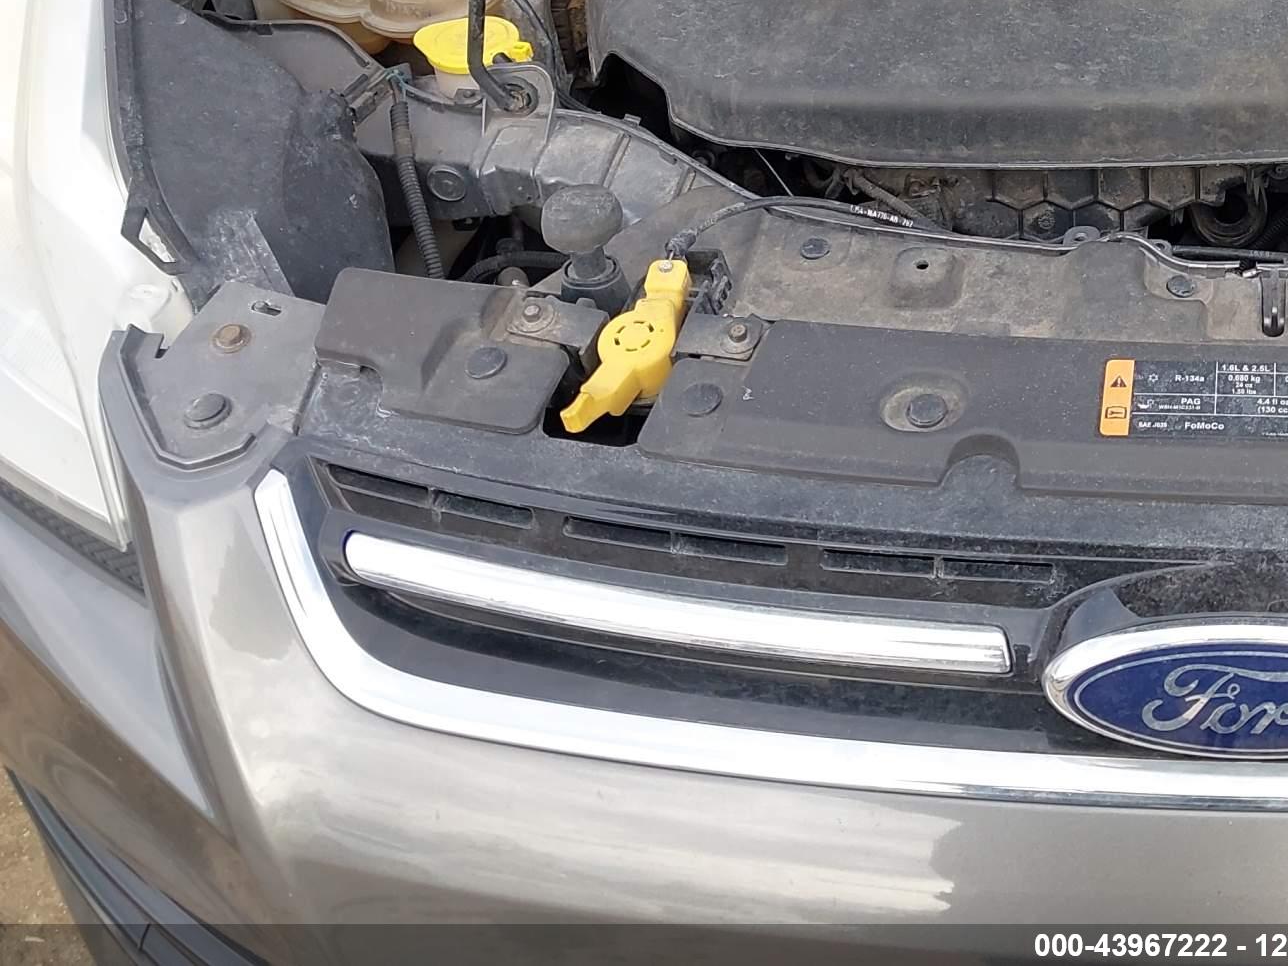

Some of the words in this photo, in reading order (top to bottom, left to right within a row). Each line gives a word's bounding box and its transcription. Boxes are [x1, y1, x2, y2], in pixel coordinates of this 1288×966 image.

[1242, 364, 1250, 372] &
[1175, 374, 1205, 383] R-134a
[1250, 374, 1261, 384] kg
[1257, 406, 1276, 414] (130
[1184, 421, 1225, 431] FoMoCo
